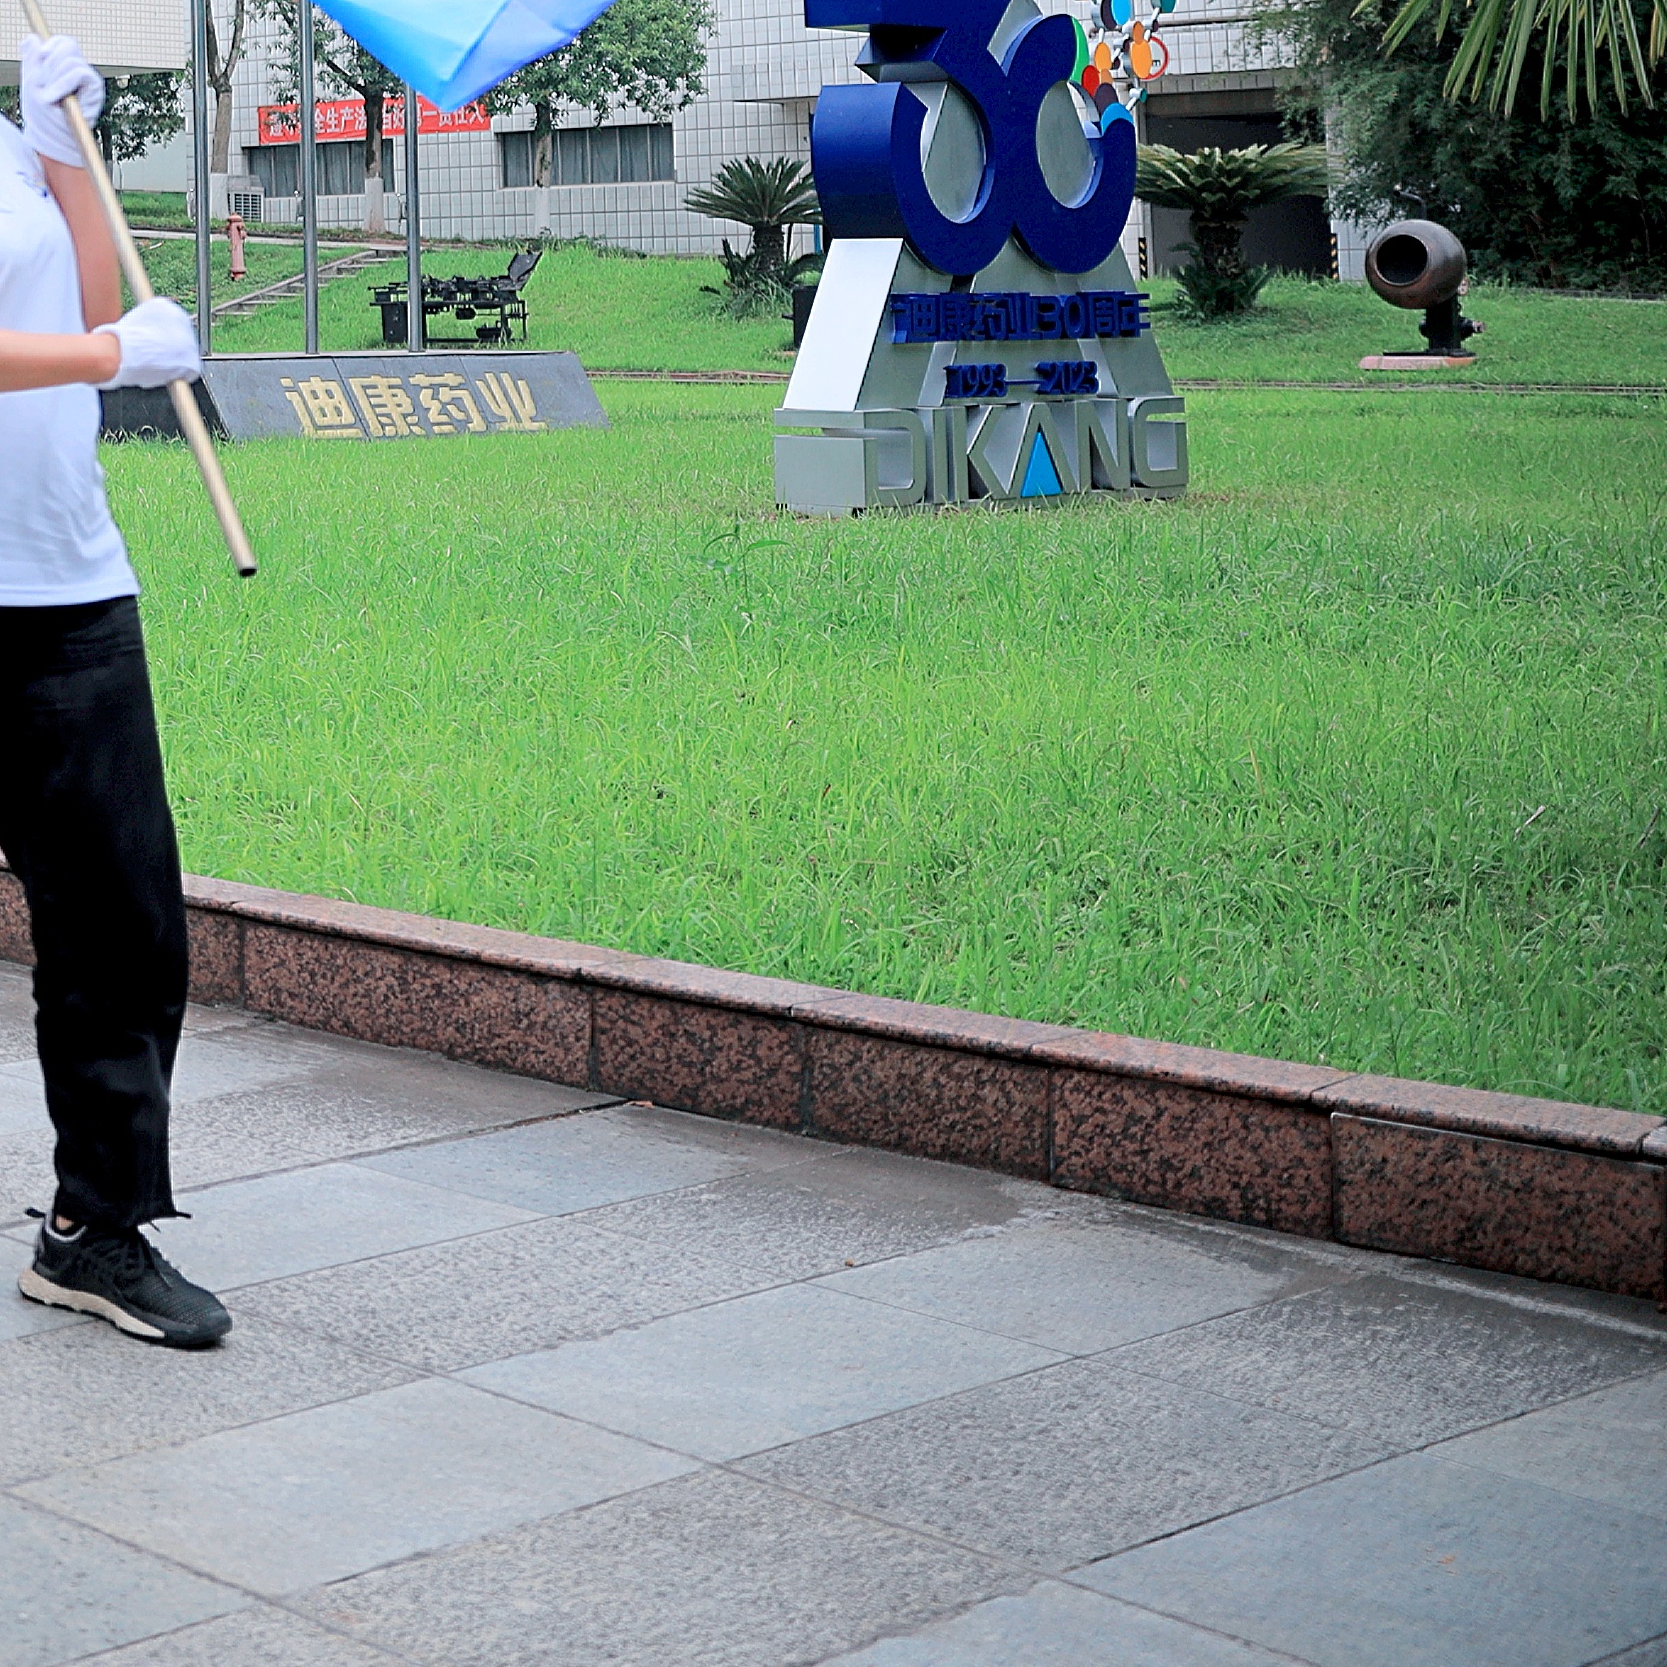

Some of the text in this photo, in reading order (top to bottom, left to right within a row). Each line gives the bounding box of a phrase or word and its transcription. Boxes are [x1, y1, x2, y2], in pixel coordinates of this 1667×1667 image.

[279, 371, 549, 439] 迪康药业
[775, 396, 1190, 512] DIKANG
